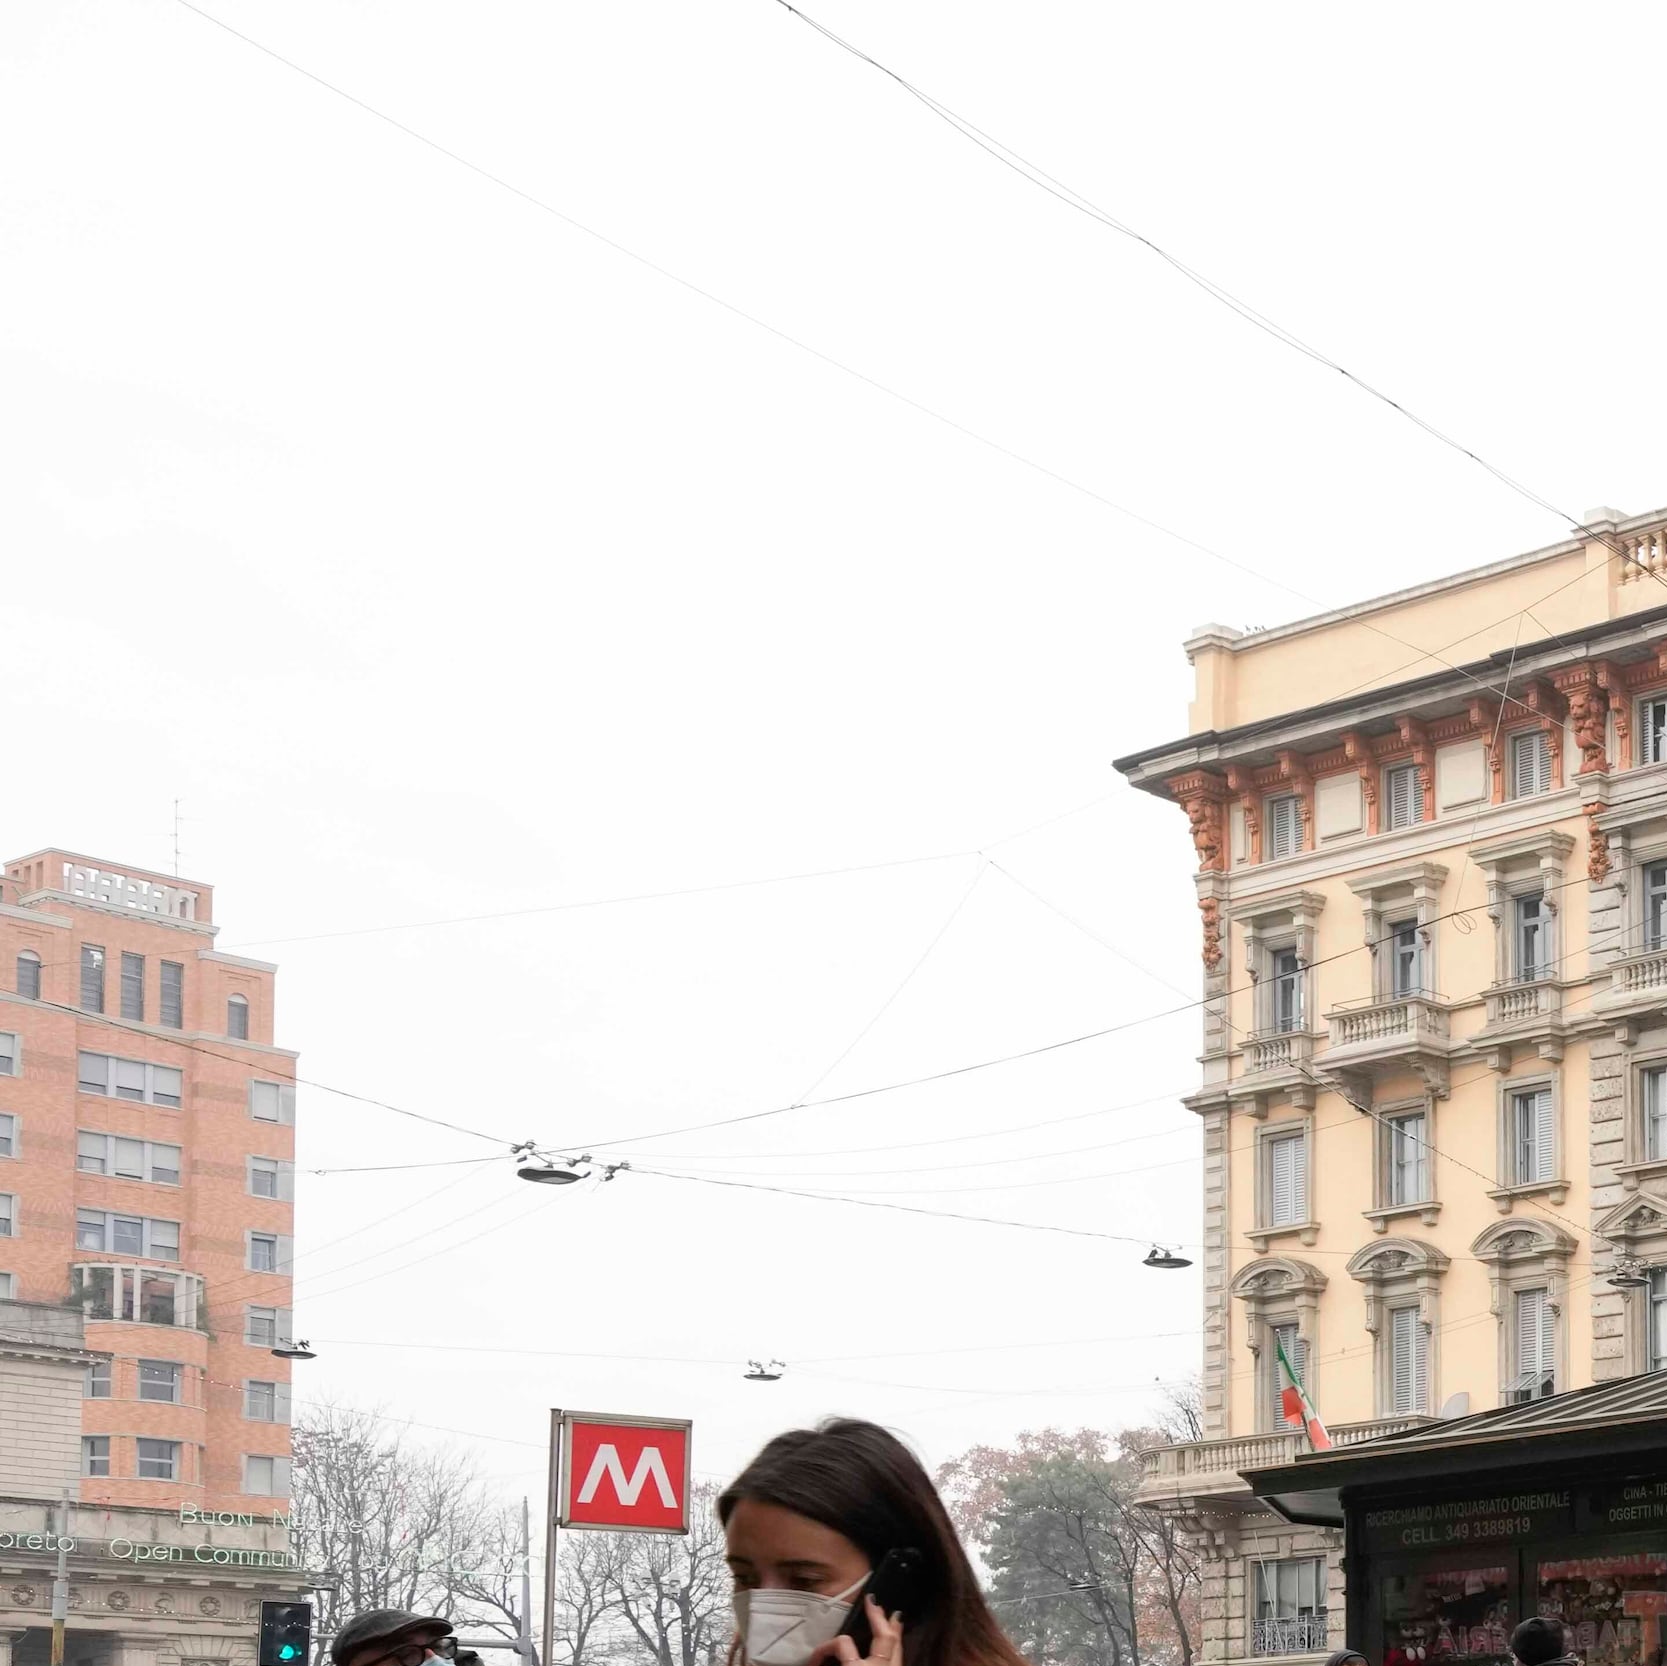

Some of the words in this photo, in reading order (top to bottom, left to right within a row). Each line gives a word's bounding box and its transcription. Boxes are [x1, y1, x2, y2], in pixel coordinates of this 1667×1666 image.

[577, 1443, 679, 1508] M
[1623, 1485, 1647, 1500] CINA
[1365, 1505, 1433, 1529] RICERCHIAMO
[1434, 1498, 1509, 1521] ANTIQUARIATO
[1511, 1491, 1571, 1512] ORIENTALE
[1609, 1504, 1651, 1522] OGGETTI
[1653, 1504, 1664, 1517] IN
[1445, 1522, 1470, 1541] 349
[1474, 1516, 1531, 1538] 3389819
[0, 1530, 75, 1551] oreto
[110, 1538, 183, 1563] Open
